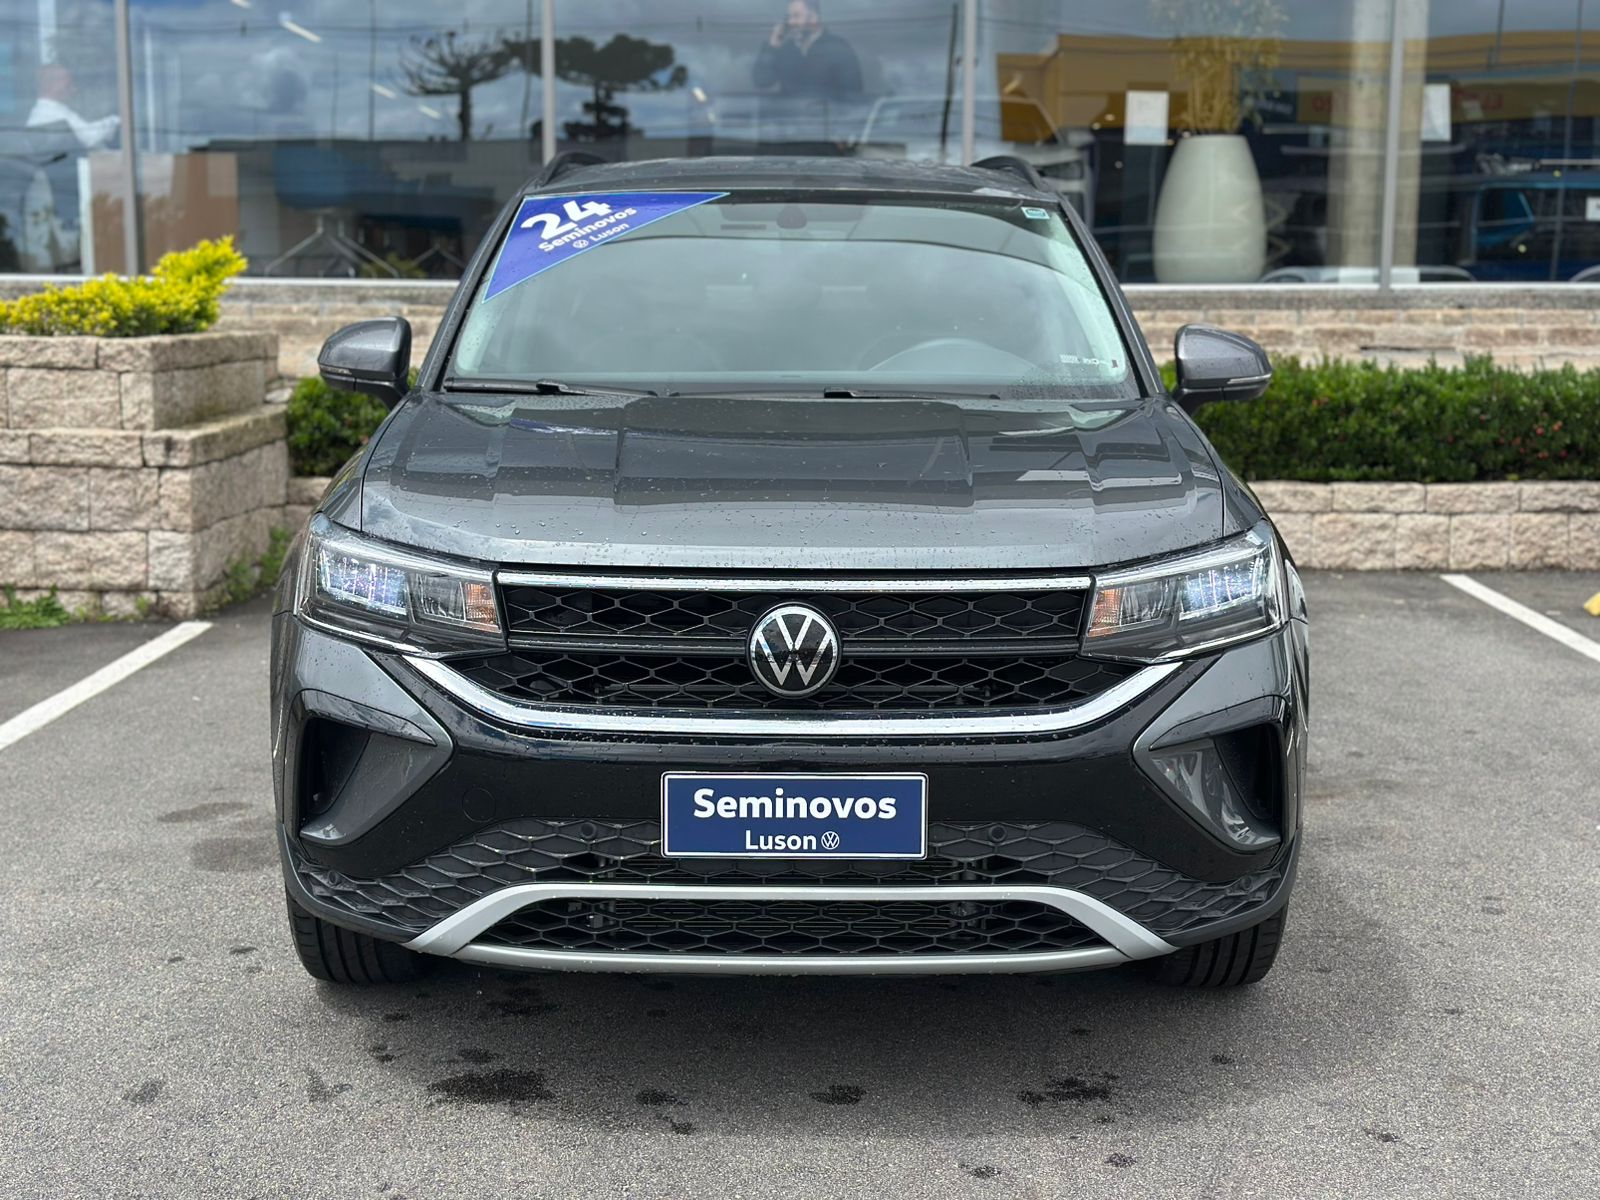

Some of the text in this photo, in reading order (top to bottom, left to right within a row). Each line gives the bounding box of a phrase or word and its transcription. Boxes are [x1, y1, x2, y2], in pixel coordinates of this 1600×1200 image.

[520, 199, 613, 240] 24
[538, 207, 637, 252] Seminovos
[589, 223, 630, 242] Luson
[750, 606, 839, 695] VW
[693, 787, 897, 819] Seminovos
[745, 829, 817, 850] Luson
